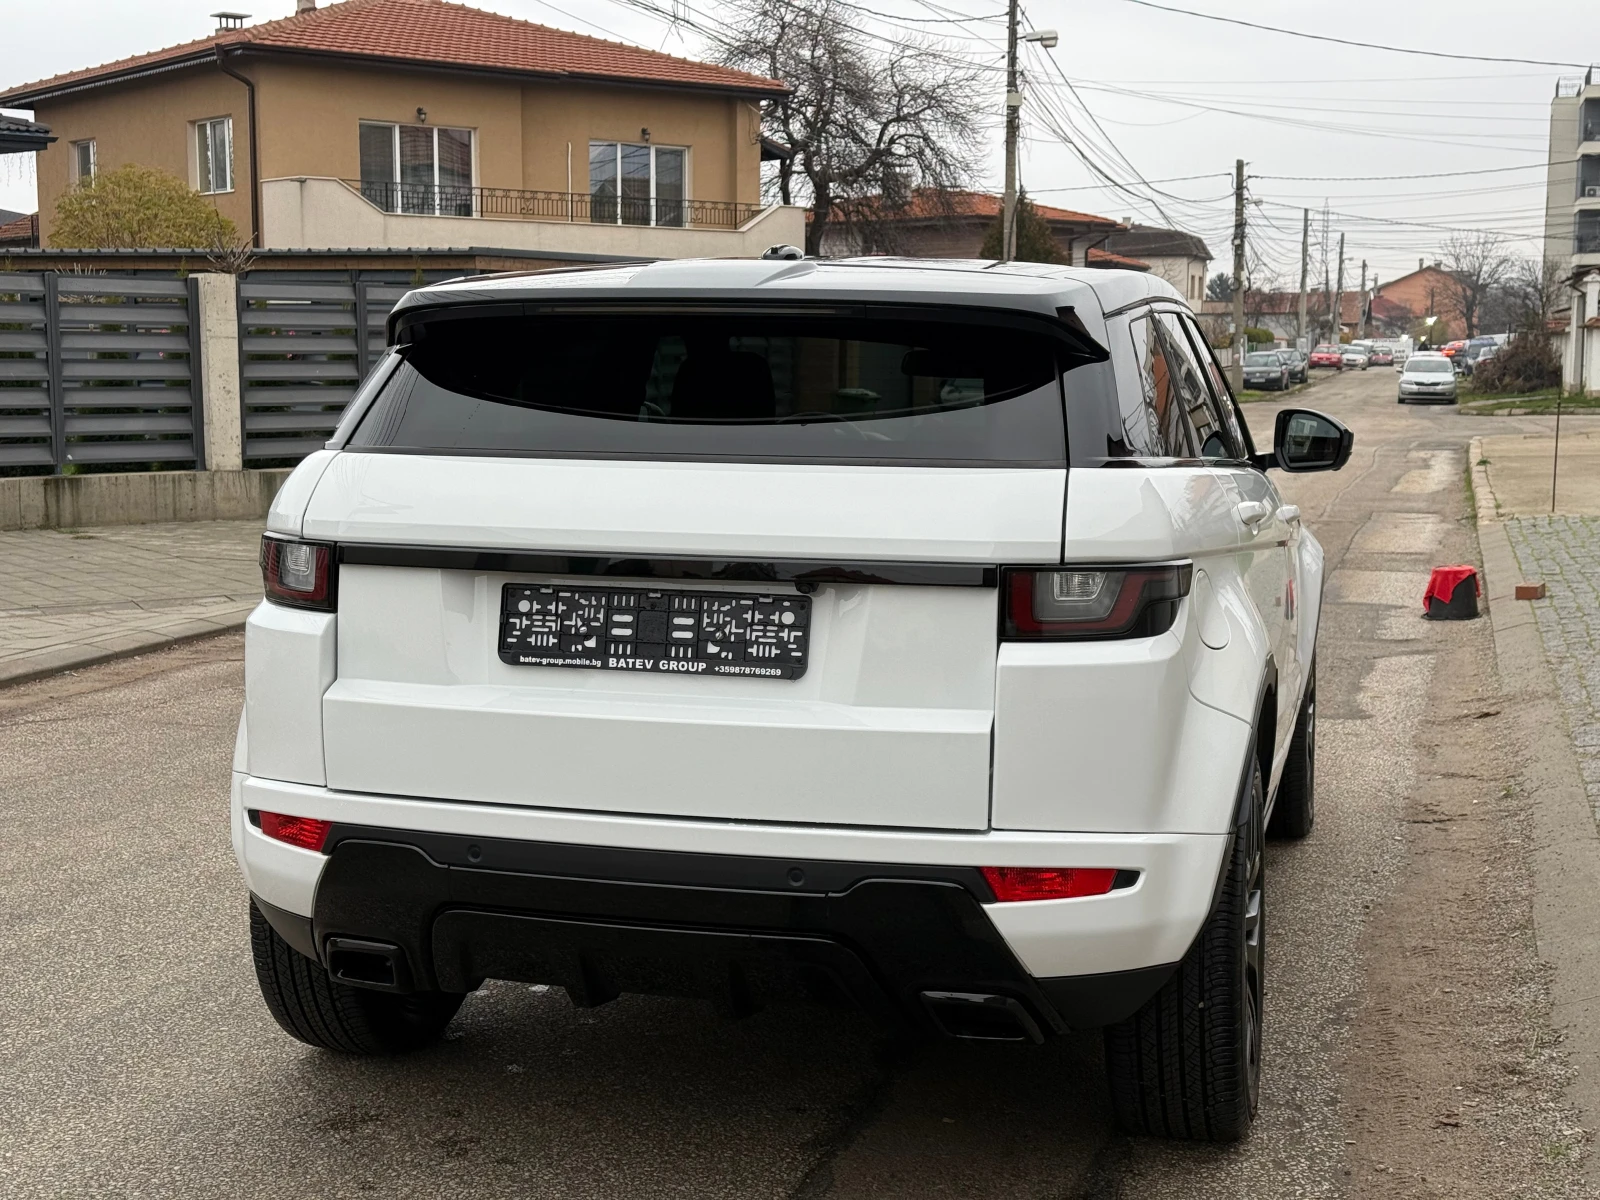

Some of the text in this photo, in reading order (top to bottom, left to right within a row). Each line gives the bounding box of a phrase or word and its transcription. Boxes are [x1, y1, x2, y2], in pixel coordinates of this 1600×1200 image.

[519, 655, 782, 676] batev-group.mobile.bg BATEV GROUP +359878769269
